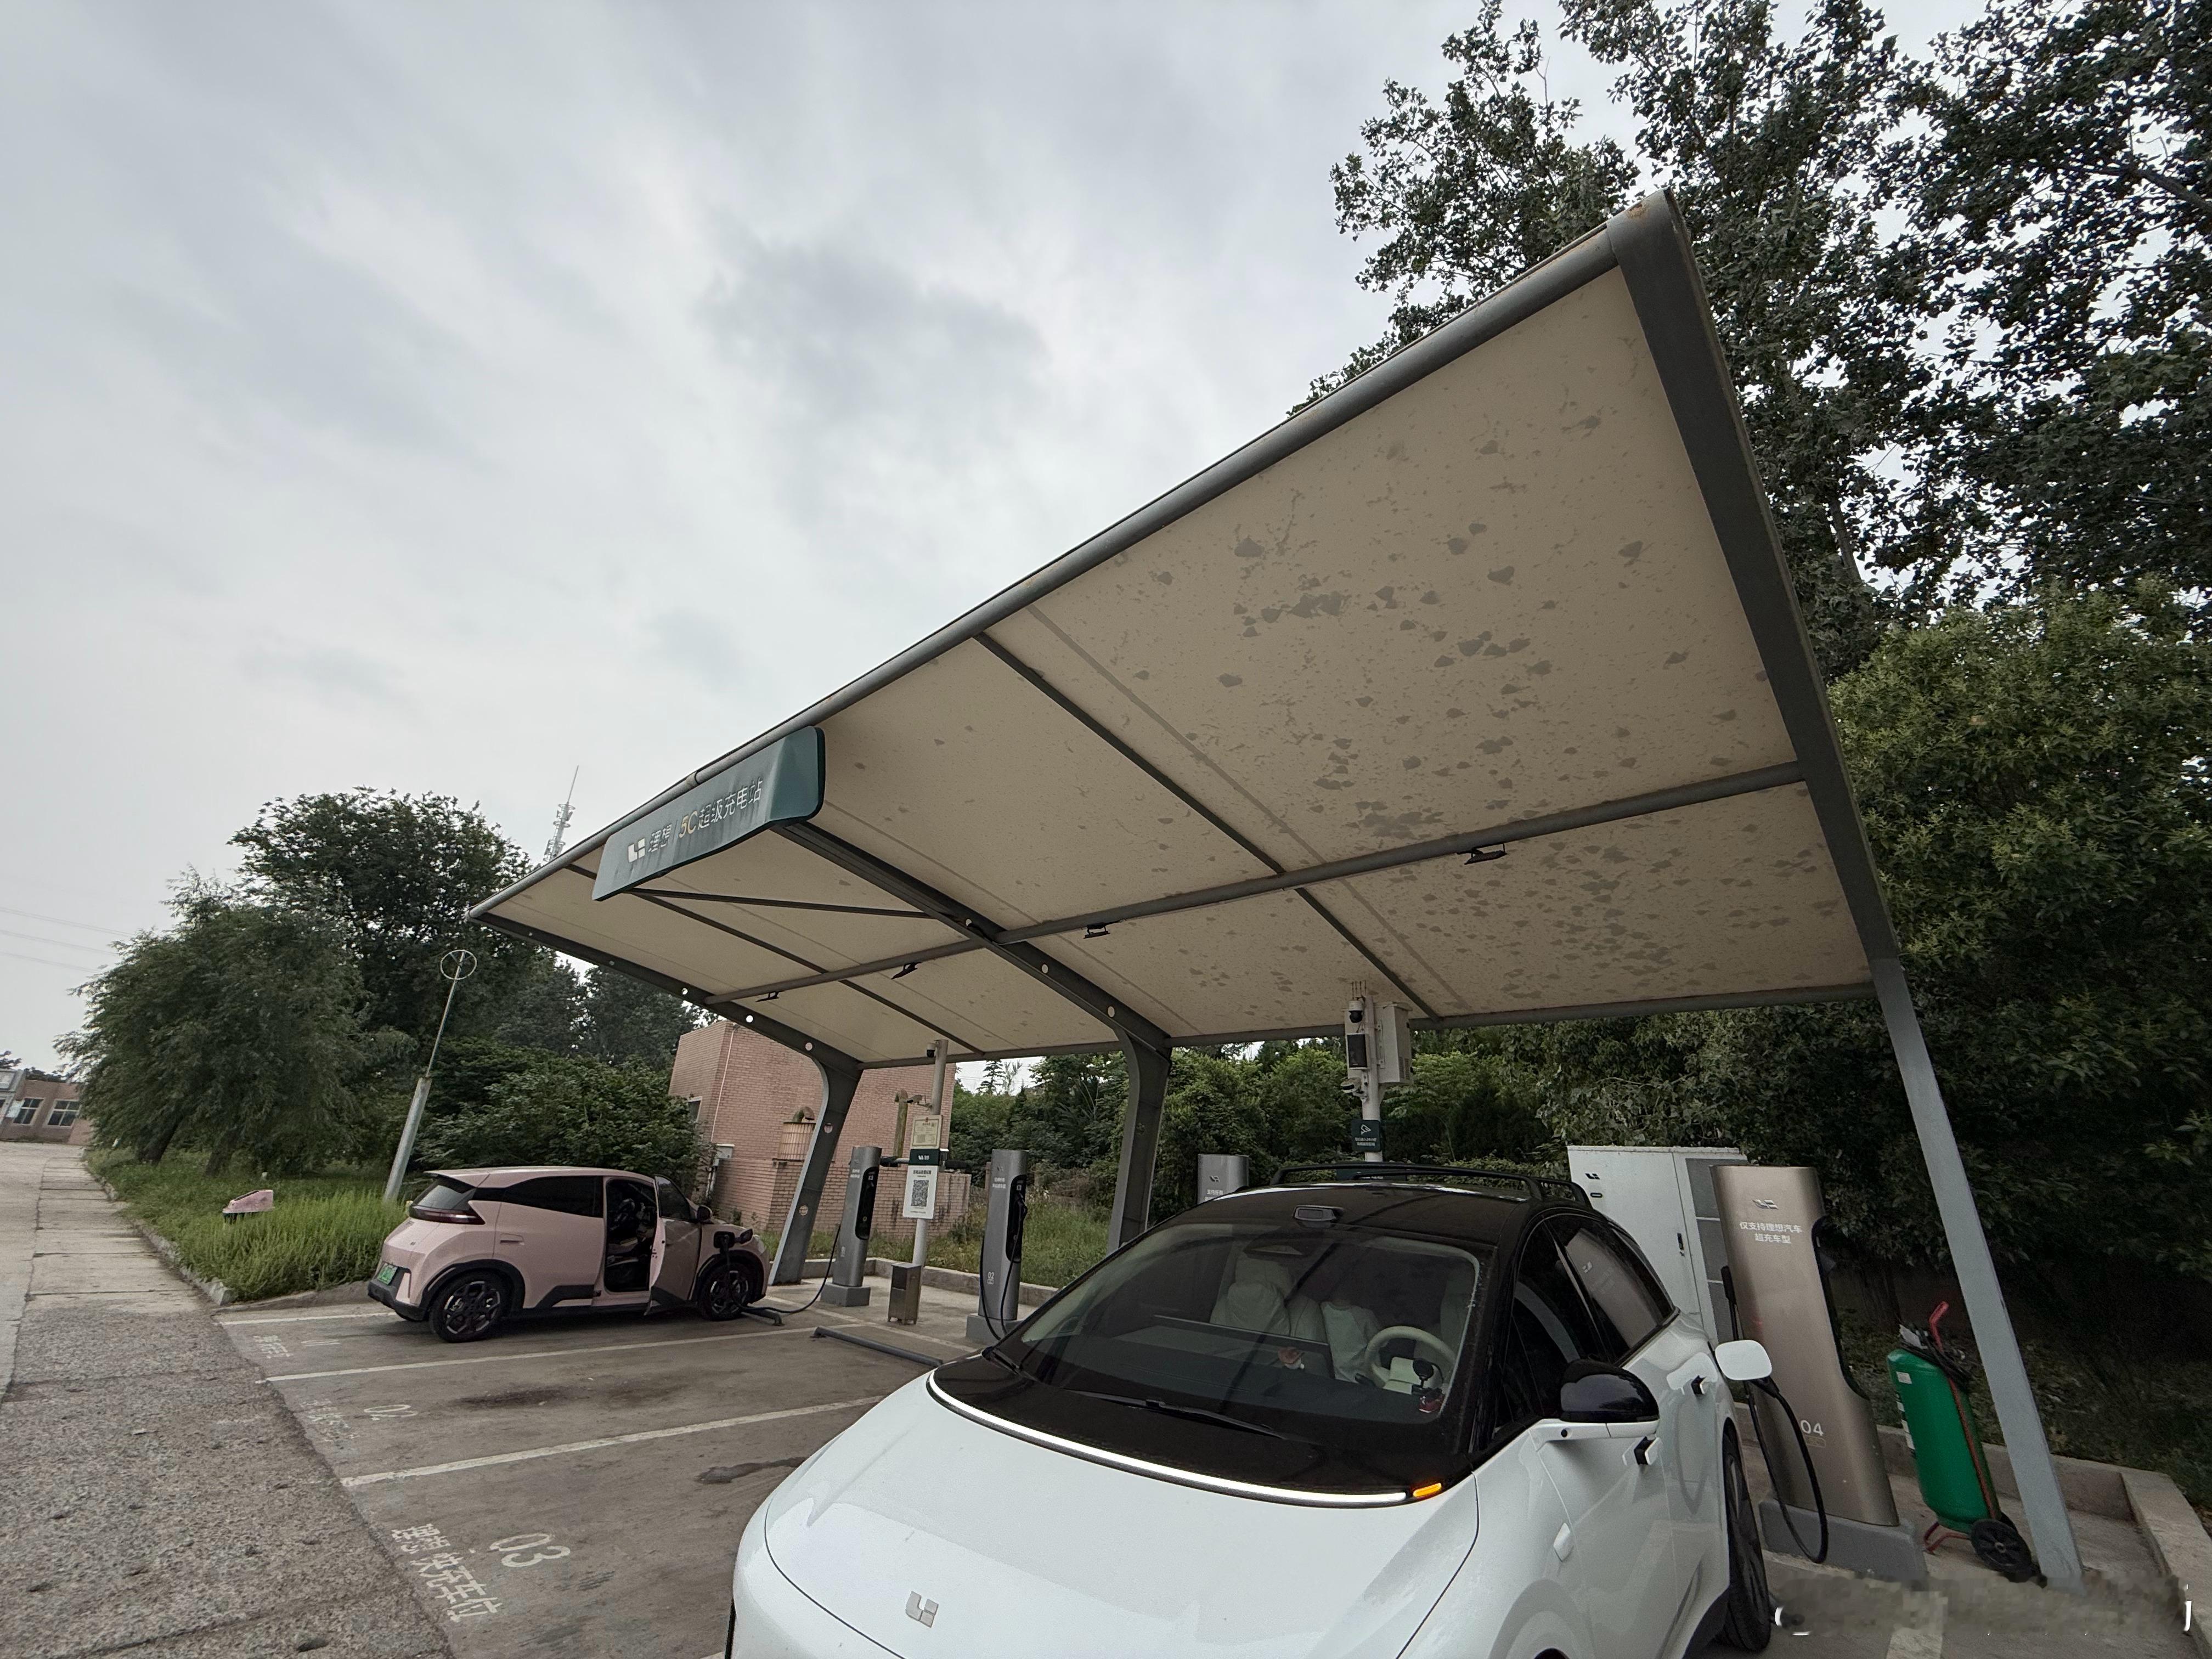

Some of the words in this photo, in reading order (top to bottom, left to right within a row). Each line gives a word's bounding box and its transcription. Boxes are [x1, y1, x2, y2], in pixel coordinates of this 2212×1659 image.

[1739, 1221, 1803, 1234] 仅支持理想汽车
[1754, 1233, 1791, 1244] 超充车型
[1800, 1419, 1824, 1436] 04
[489, 1533, 571, 1568] 03
